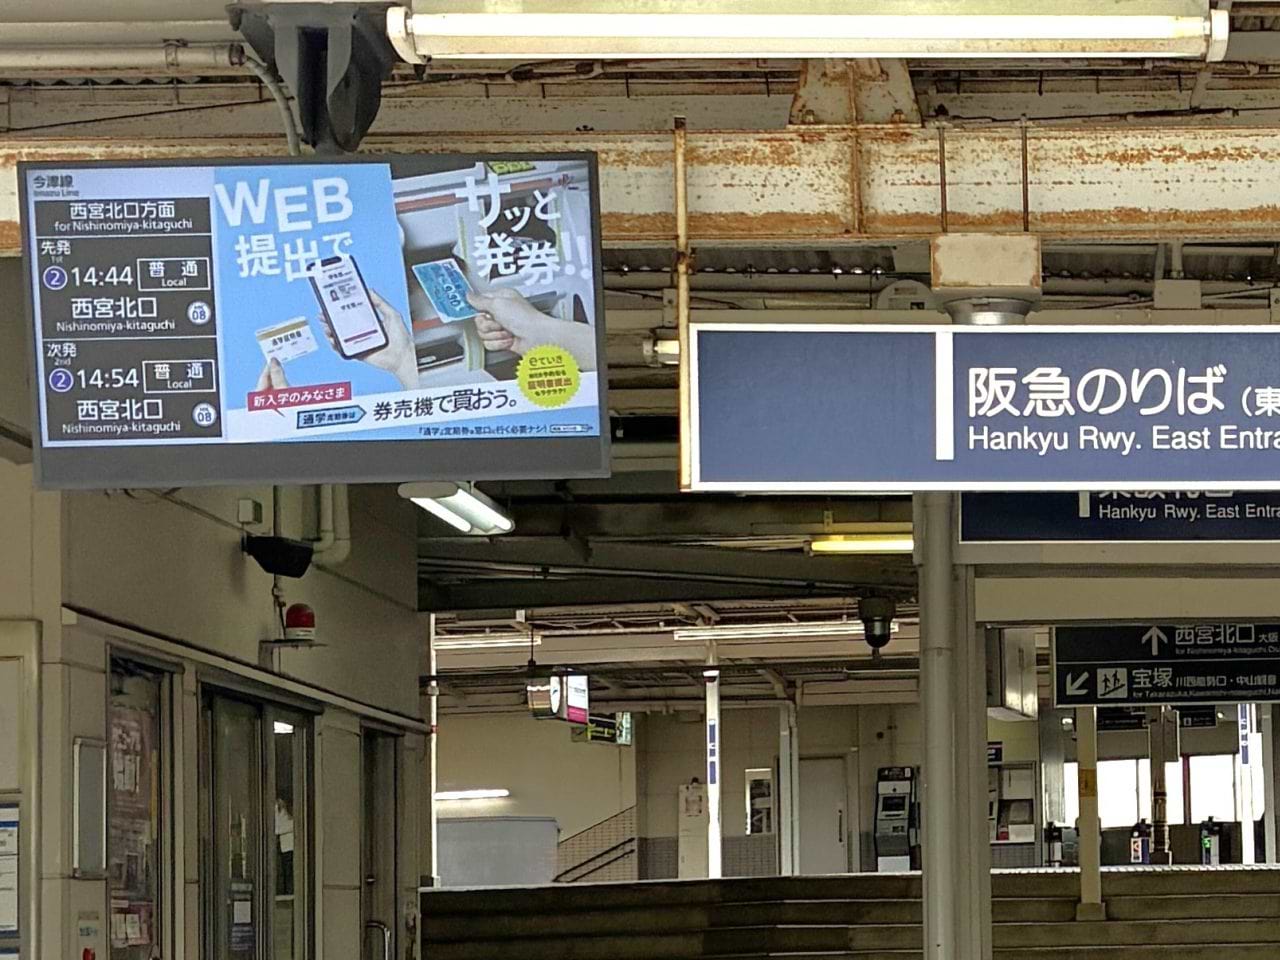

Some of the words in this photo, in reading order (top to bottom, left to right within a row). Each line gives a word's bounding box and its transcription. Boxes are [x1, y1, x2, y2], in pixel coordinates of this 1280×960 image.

[69, 200, 175, 219] 西宮北口方面
[215, 177, 354, 234] WEB
[455, 171, 562, 228] サッと
[54, 221, 71, 231] for
[72, 219, 193, 232] Nishinomiya-kitaguchi
[40, 240, 71, 256] 先発
[234, 232, 354, 282] 提出で
[71, 266, 134, 287] 14:44
[161, 277, 187, 288] Local
[71, 297, 157, 319] 西宮北口
[56, 320, 176, 333] Nishinomiya-kitaguchi
[47, 342, 77, 358] 次発
[77, 368, 139, 389] 14:54
[167, 379, 192, 389] Local
[253, 387, 345, 407] 新入学のみなさま
[968, 363, 1228, 418] 阪急のりば
[77, 399, 163, 420] 西宮北口
[373, 388, 518, 422] 券売機で買おう。
[62, 421, 181, 435] Nishinomiya-kitaguchi
[968, 425, 1069, 456] Hankyu
[1079, 425, 1142, 456] Rwy.
[1152, 425, 1211, 450] East
[1099, 504, 1157, 522] Hankyu
[1164, 504, 1200, 522] Rwy.
[1206, 504, 1240, 519] East
[1175, 624, 1255, 645] 西宮北口
[1132, 667, 1173, 688] 宝塚
